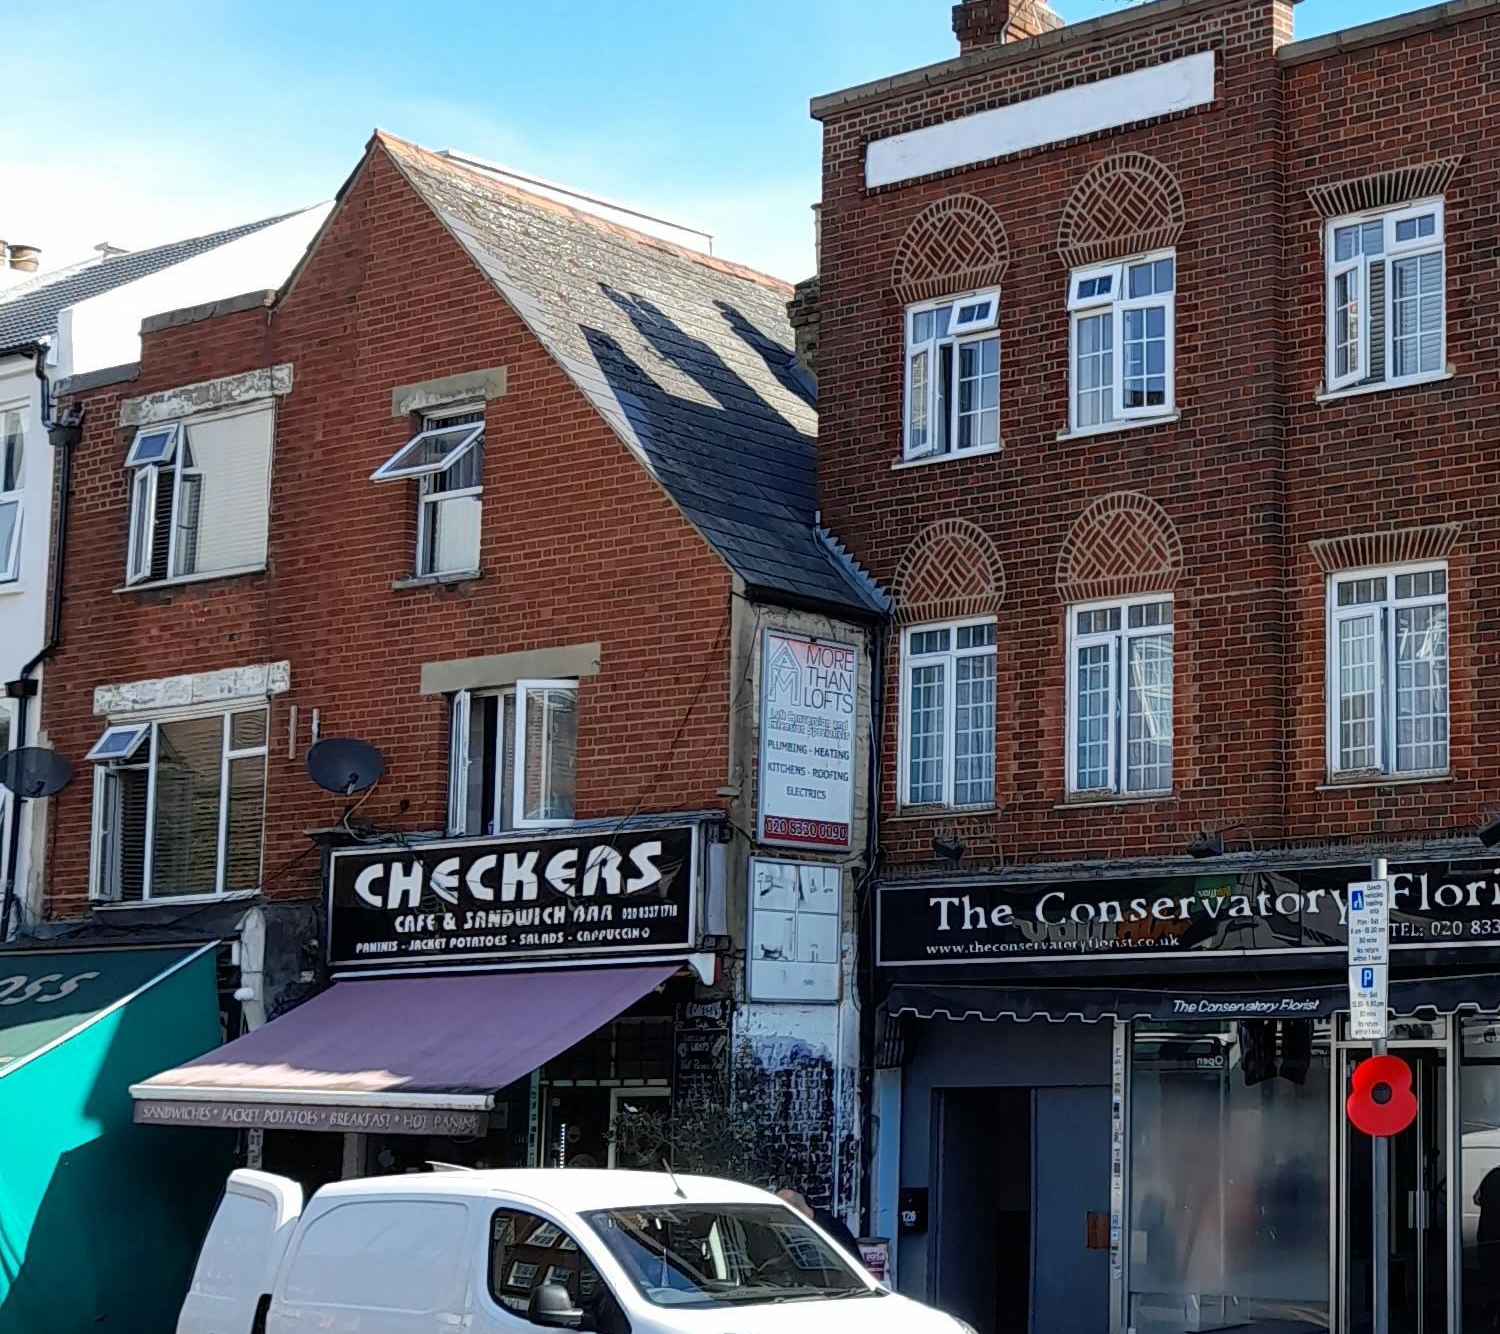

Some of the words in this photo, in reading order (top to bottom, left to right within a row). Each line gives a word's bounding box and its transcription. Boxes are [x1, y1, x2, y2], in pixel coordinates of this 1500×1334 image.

[806, 645, 854, 673] MORE
[807, 666, 851, 693] THAN
[804, 687, 854, 714] LOFTS
[768, 739, 807, 755] PLUMBING
[814, 747, 850, 761] HEATING
[768, 761, 806, 776] KITCHENS
[812, 768, 849, 782] ROOFING
[786, 786, 827, 800] ELECTRICS
[766, 817, 787, 833] 020
[819, 823, 847, 839] 0090
[354, 841, 663, 909] CHECKERS
[394, 914, 435, 933] CAFE
[442, 912, 458, 930] &
[463, 905, 566, 929] SANDWICH
[573, 904, 613, 923] BAR
[929, 894, 1013, 931] The
[1035, 886, 1349, 925] Conservatory
[356, 940, 398, 953] PANINIS
[408, 937, 447, 951] JACKET
[450, 934, 508, 949] POTATOES
[519, 931, 564, 945] SALADS
[577, 927, 651, 941] CAPPUCCINO
[1388, 922, 1425, 938] TEL:
[1431, 920, 1463, 937] 020
[926, 934, 1180, 955] www.theconservatoryflorist.co.uk
[1363, 969, 1372, 986] P
[1173, 999, 1196, 1013] The
[1198, 999, 1280, 1013] Conservatory
[1279, 999, 1320, 1011] Florist
[142, 1105, 211, 1120] SANDWICHES
[221, 1107, 258, 1123] JACKET
[263, 1109, 319, 1125] POTATOES
[329, 1111, 391, 1128] BREAKFAST
[403, 1113, 427, 1129] HOT
